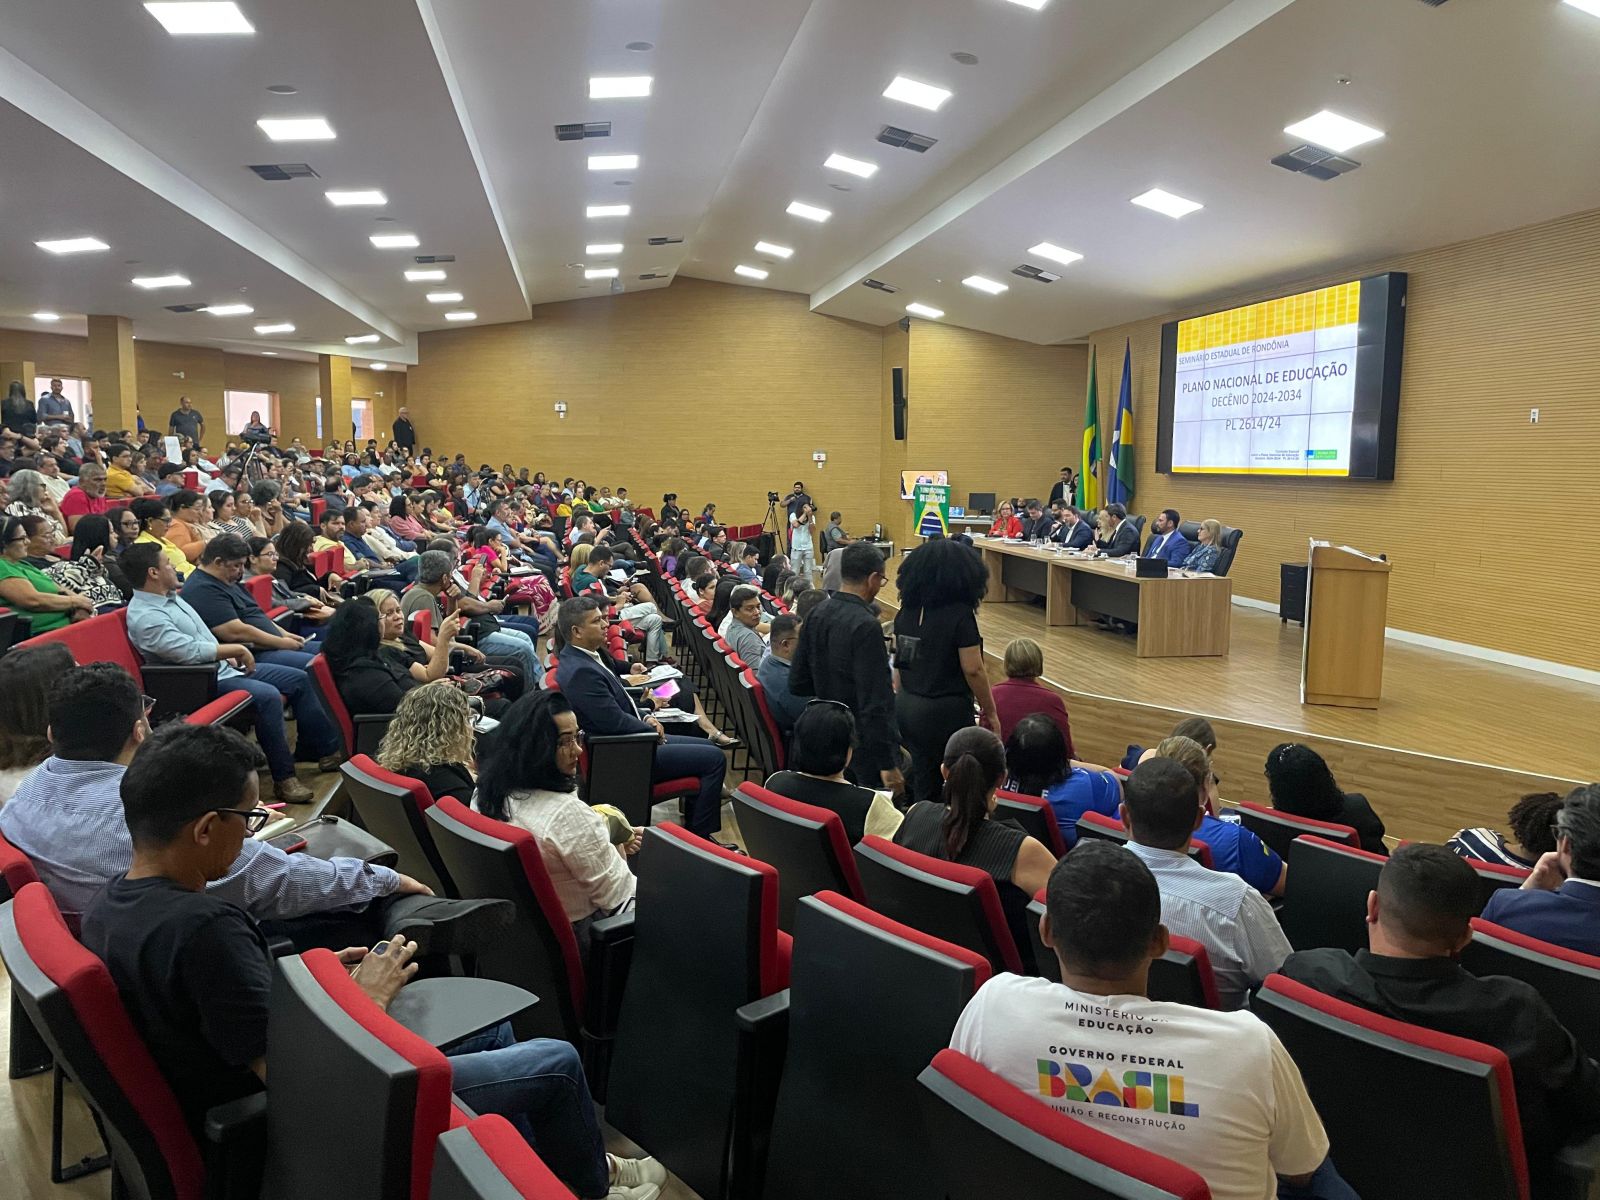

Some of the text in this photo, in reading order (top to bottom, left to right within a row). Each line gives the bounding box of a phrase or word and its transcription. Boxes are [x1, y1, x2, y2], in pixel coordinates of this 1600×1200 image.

[1179, 339, 1289, 365] SEMINÁRIO ESTADUAL DE RONDÔNIA
[1182, 362, 1348, 393] PLANO NACIONAL DE EDUCAÇÃO
[1211, 389, 1302, 408] DECÊNIO 2024-2034
[1225, 415, 1281, 432] PL 2614/24
[1078, 1018, 1154, 1035] EDUCAÇÃO
[1049, 1045, 1184, 1069] GOVERNO FEDERAL
[1036, 1058, 1200, 1118] BRASIL
[1088, 1110, 1094, 1118] E
[1098, 1112, 1186, 1131] RECONSTRUÇÃO
